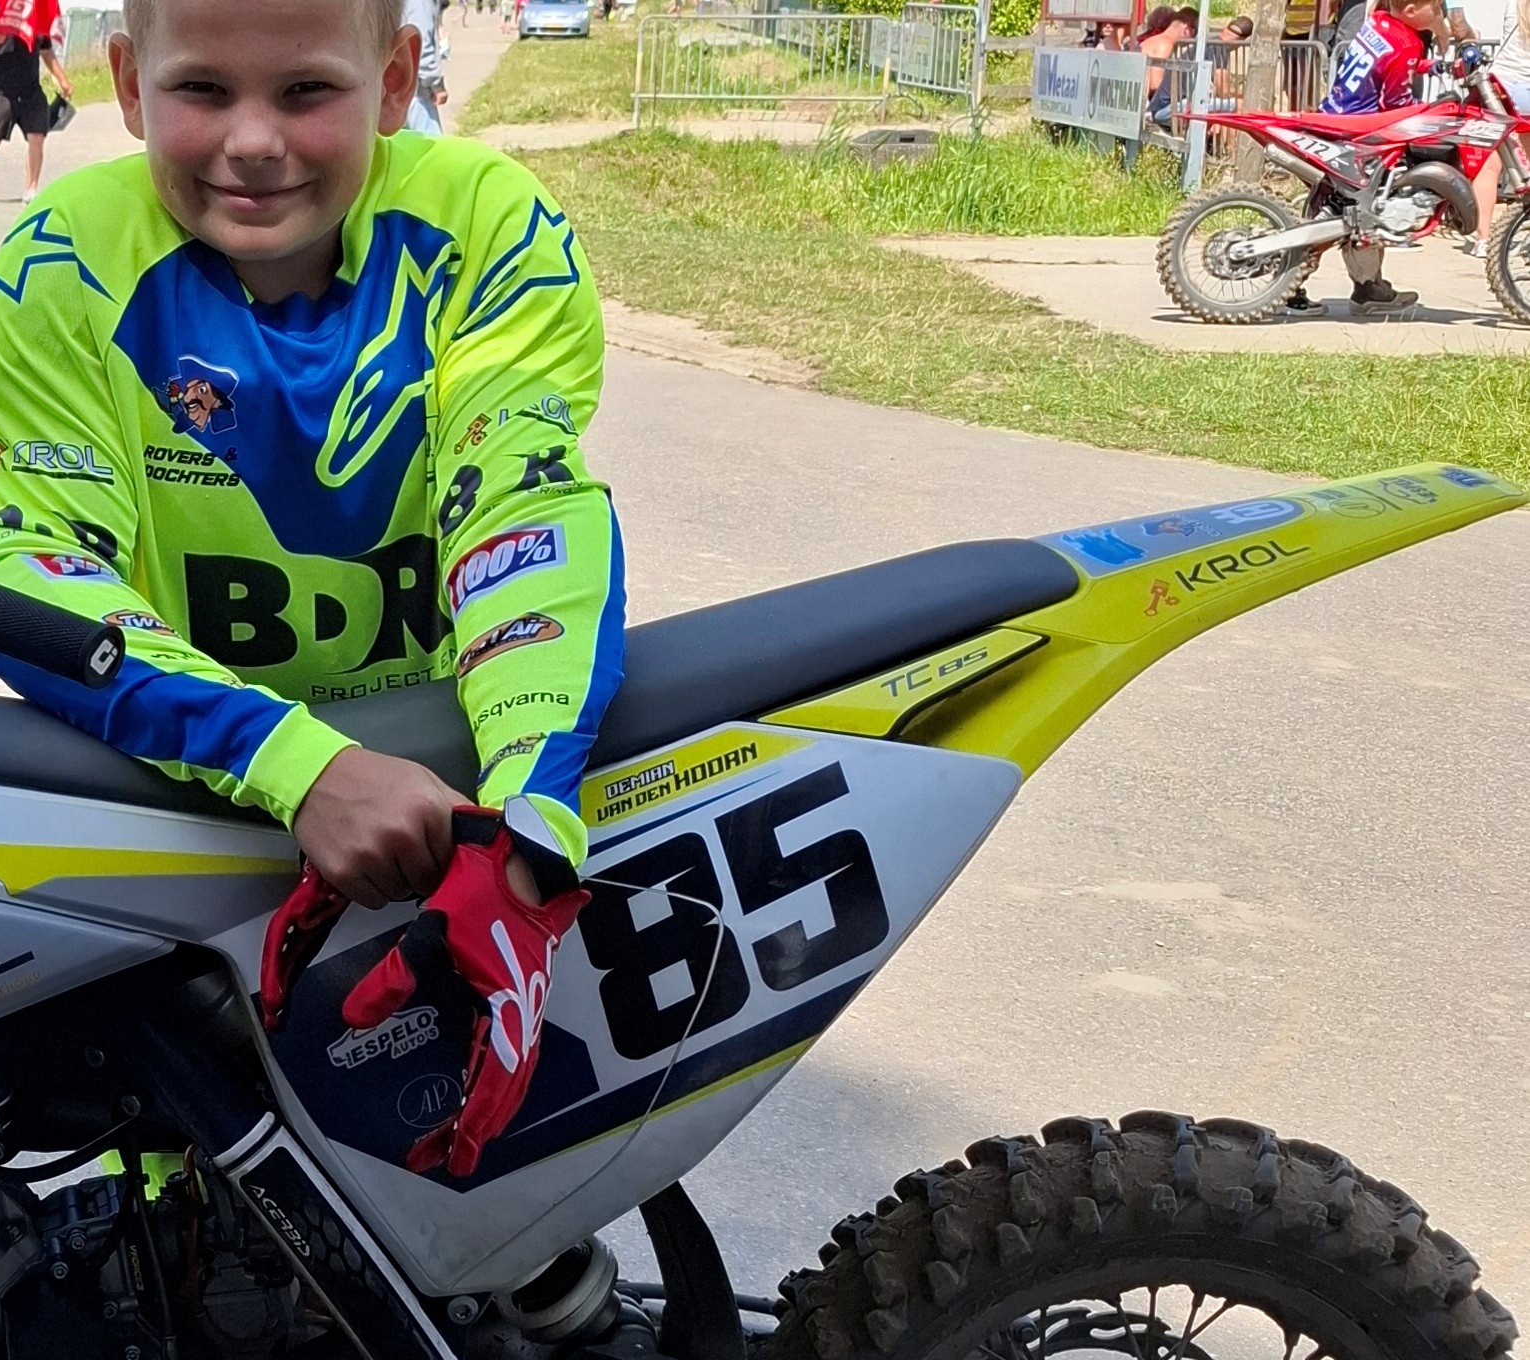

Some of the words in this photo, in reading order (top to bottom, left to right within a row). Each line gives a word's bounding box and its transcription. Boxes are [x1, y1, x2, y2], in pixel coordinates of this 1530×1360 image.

[144, 445, 216, 467] ROVERS
[224, 446, 238, 462] &
[452, 529, 552, 607] 100%
[1175, 540, 1311, 592] KROL
[311, 657, 435, 700] PROJECT
[880, 662, 934, 698] TC
[937, 646, 988, 679] 85
[473, 691, 570, 732] usqvarna
[597, 796, 633, 822] VAN
[636, 782, 671, 807] DEN
[674, 742, 758, 791] HOORN
[605, 760, 675, 800] DEMIAN
[578, 760, 890, 1061] 85
[393, 1027, 438, 1057] AUTO'S
